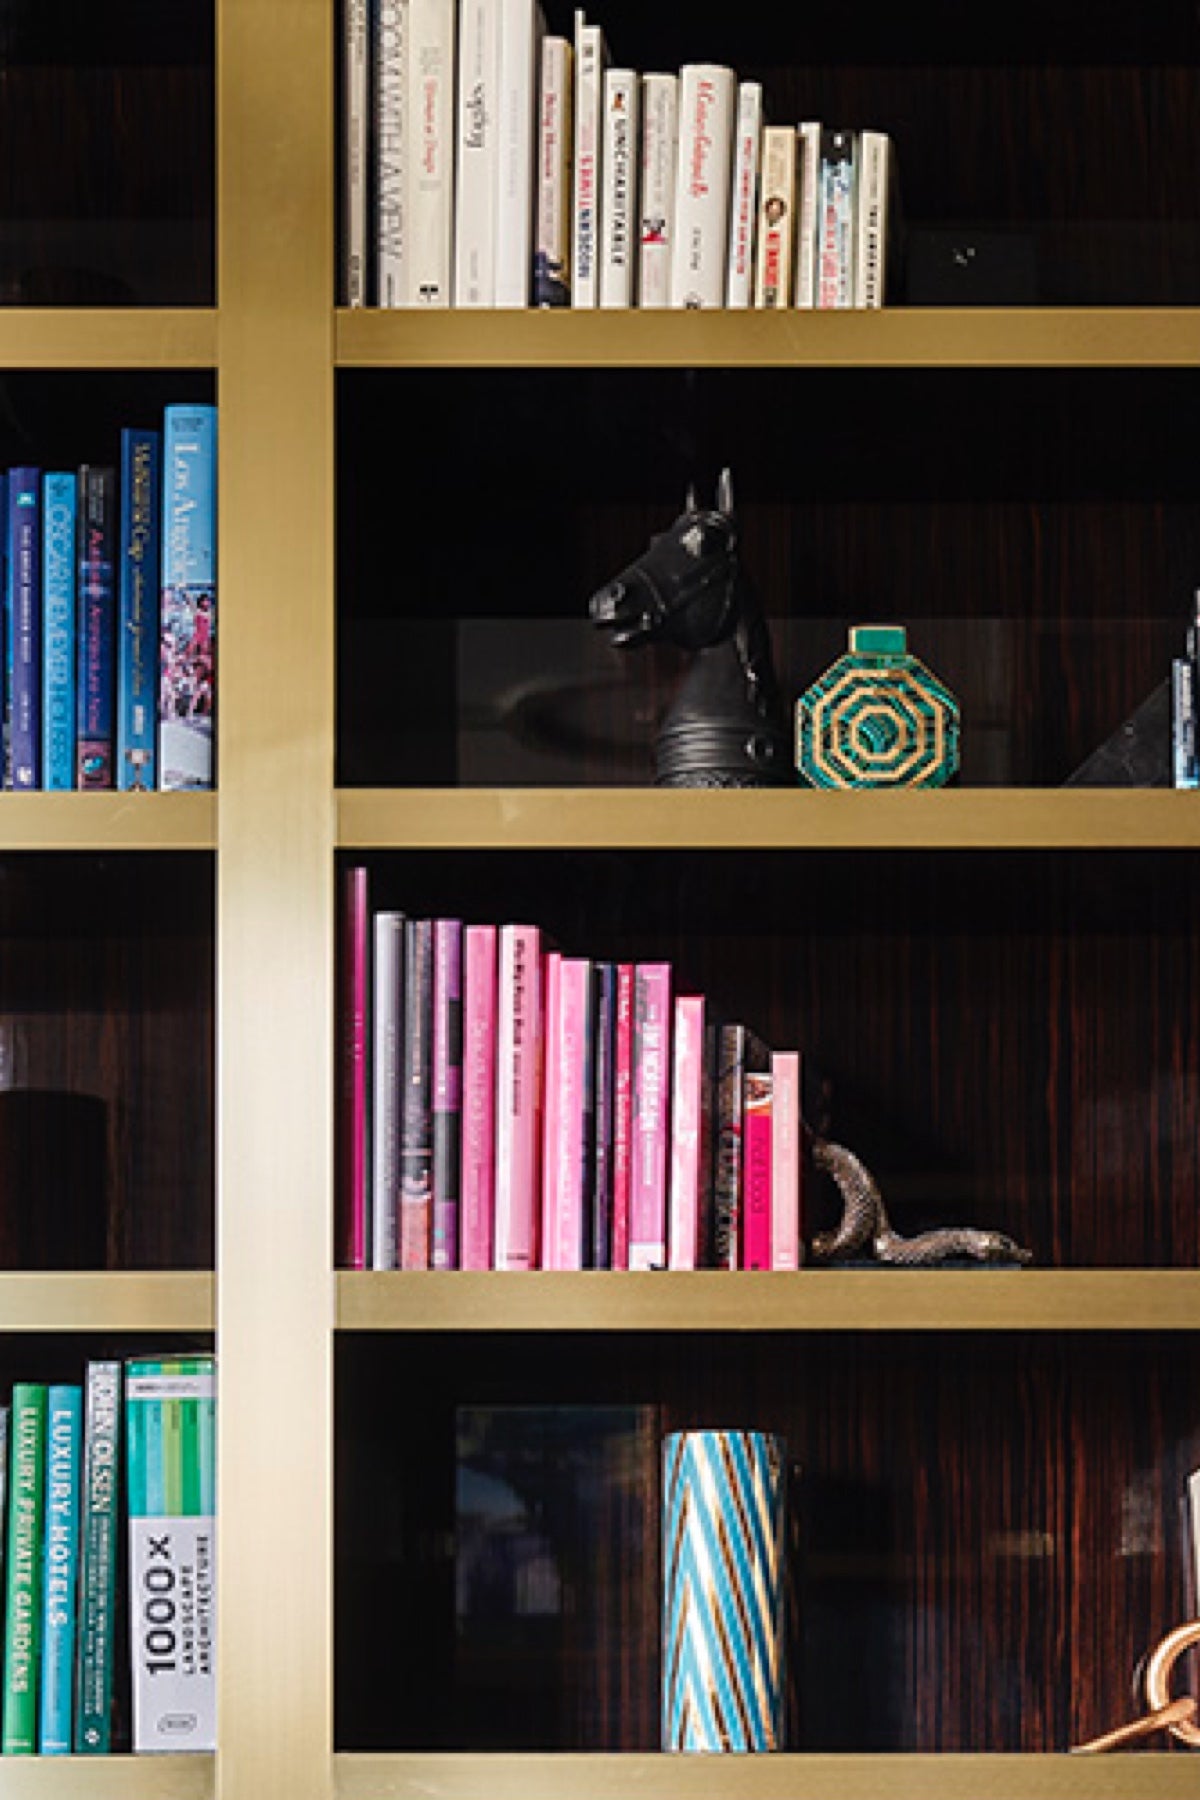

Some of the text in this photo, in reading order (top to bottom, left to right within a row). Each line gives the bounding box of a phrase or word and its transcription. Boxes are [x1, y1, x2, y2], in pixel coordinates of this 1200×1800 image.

[379, 0, 402, 78] OOM
[48, 504, 71, 582] OSCAR
[168, 441, 197, 589] Los Angeles
[49, 1410, 72, 1626] LUXURY HOTELS
[91, 1436, 113, 1513] OLSEN
[12, 1407, 37, 1693] LUXURY PRIVATE GARDENS
[198, 1535, 210, 1675] ARCHITECTURE
[183, 1564, 194, 1675] LANDSCAPE
